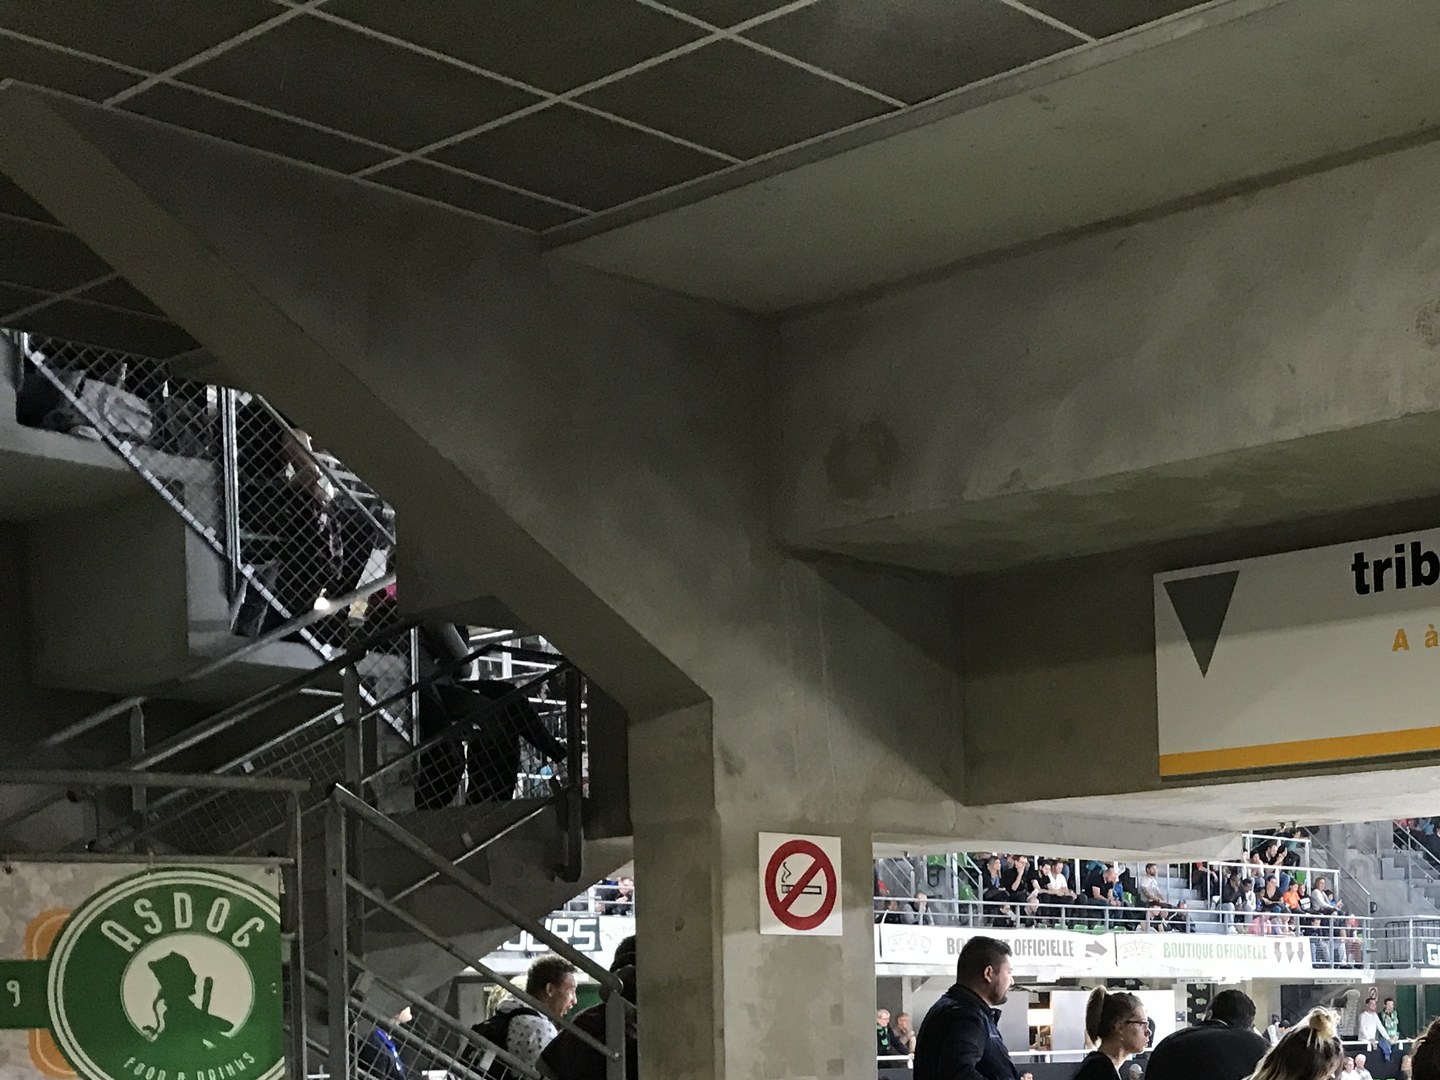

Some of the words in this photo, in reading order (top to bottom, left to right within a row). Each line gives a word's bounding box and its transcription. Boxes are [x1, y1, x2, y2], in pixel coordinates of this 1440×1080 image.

[1392, 628, 1409, 651] A
[1424, 624, 1439, 648] à
[100, 892, 265, 952] ASDOG
[1014, 938, 1074, 957] OFFICIELLE
[1163, 942, 1214, 960] BOUTIQUE
[1216, 943, 1268, 960] OFFICIELLE
